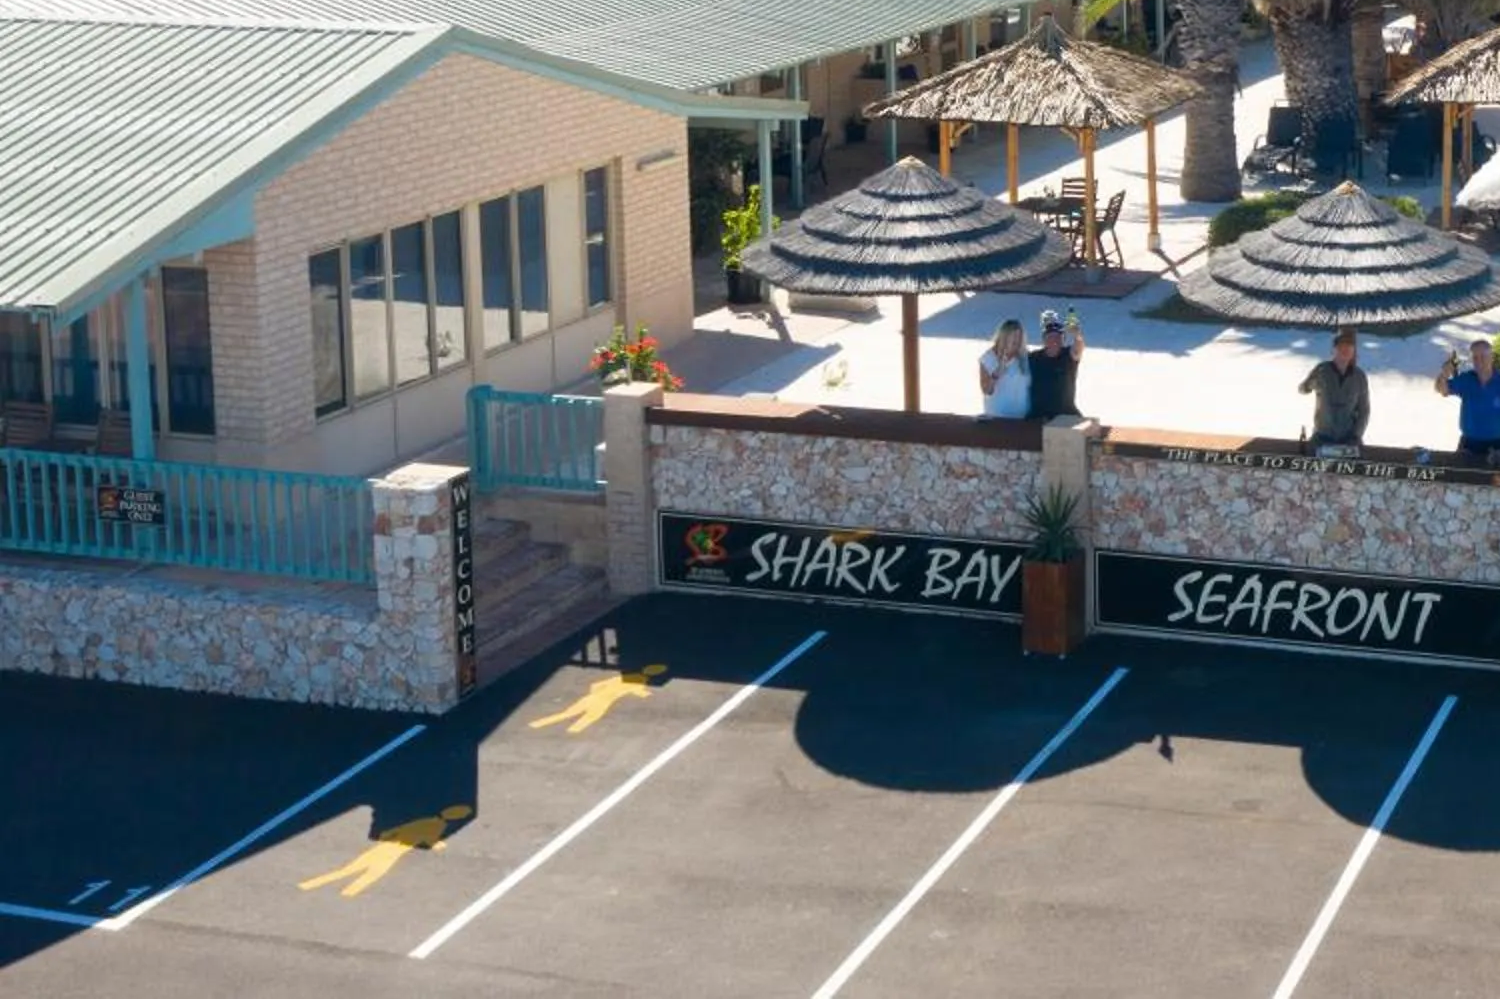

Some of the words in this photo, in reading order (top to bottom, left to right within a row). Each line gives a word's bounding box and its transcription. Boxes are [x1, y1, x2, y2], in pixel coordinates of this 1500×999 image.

[1262, 455, 1284, 468] TO
[1290, 457, 1329, 472] STAY
[1336, 461, 1357, 474] IN
[1364, 463, 1397, 477] THE
[453, 483, 474, 652] WELCOME
[746, 532, 907, 594] SHARK
[921, 547, 1023, 603] BAY
[1167, 570, 1442, 644] SEAFRONT
